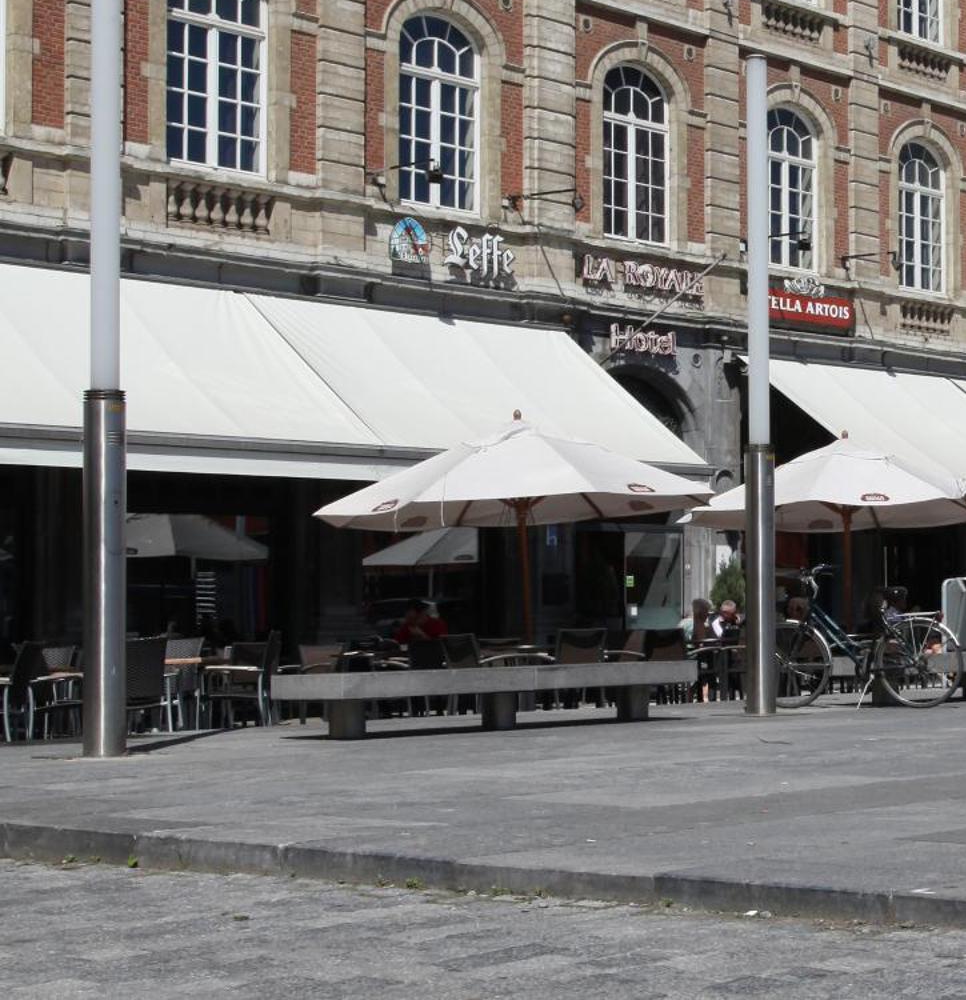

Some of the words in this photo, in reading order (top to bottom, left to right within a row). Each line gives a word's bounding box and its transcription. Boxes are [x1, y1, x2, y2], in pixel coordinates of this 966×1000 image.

[444, 226, 514, 280] Leffe
[584, 254, 615, 282] LA
[623, 260, 704, 296] ROYALE
[806, 301, 850, 320] ARTOIS
[610, 323, 677, 356] Hotel
